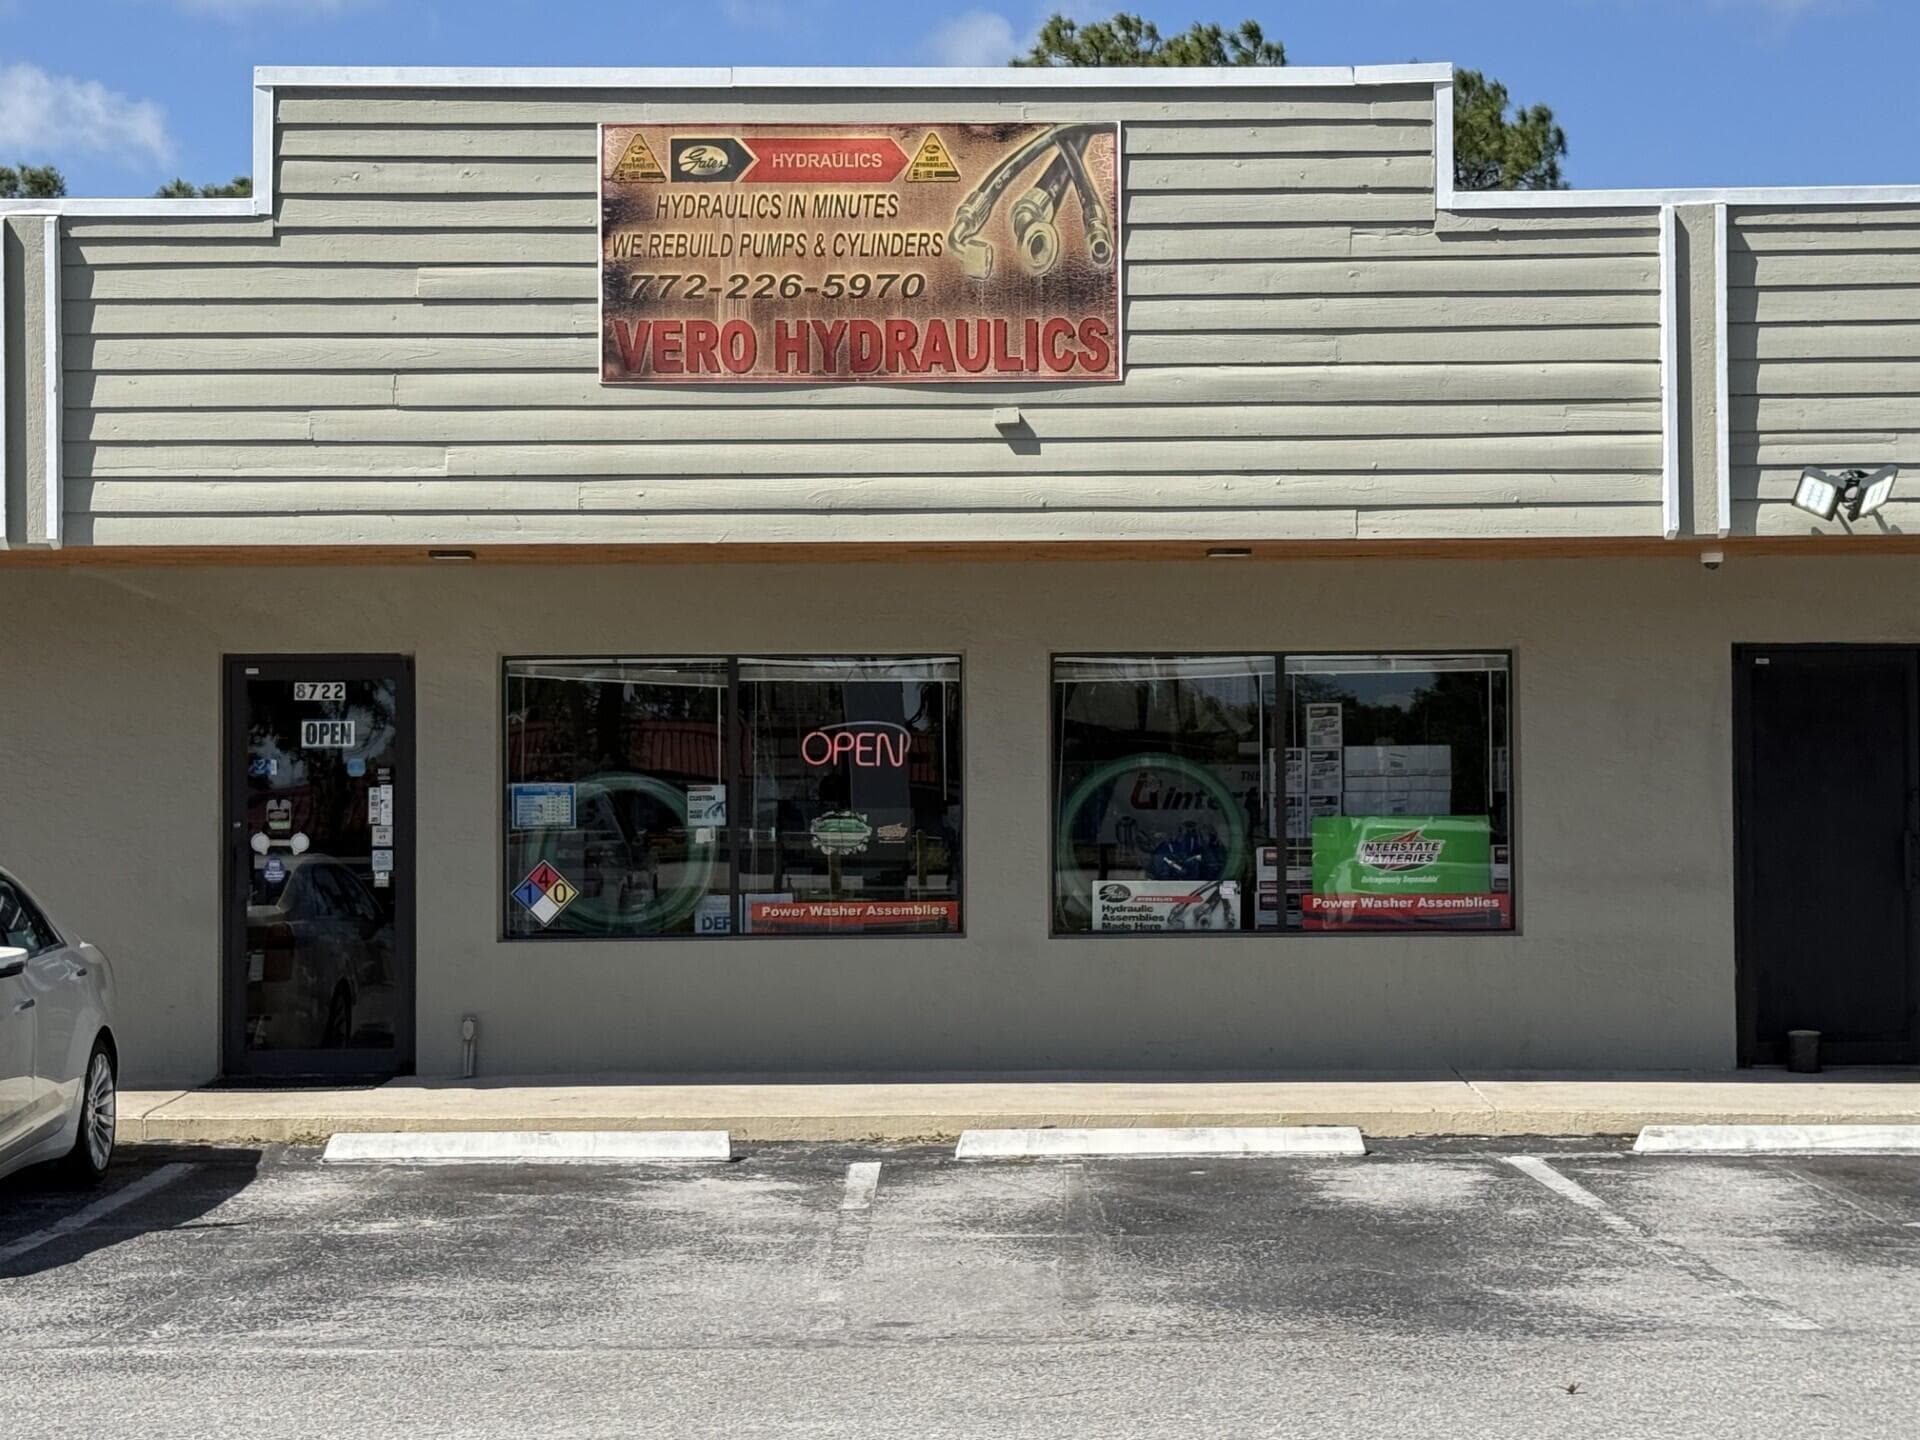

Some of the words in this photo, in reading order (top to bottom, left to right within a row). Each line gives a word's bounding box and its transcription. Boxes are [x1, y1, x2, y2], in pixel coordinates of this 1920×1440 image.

[680, 148, 728, 172] Gates
[772, 153, 883, 168] HYDRAULICS
[656, 193, 782, 220] HYDRAULICS
[787, 194, 807, 219] IN
[812, 193, 899, 219] MINUTES
[612, 233, 643, 258] WE
[649, 233, 733, 258] REBUILD
[739, 232, 807, 258] PUMPS
[813, 232, 826, 257] &
[833, 232, 943, 257] CYLINDERS
[630, 272, 926, 299] 772-226-5970
[614, 319, 757, 374] VERO
[775, 317, 1110, 374] HYDRAULICS
[296, 684, 344, 699] 8722
[305, 723, 352, 745] OPEN
[801, 731, 904, 767] OPEN
[1361, 842, 1440, 852] INTERSTATE
[538, 868, 549, 889] 4
[523, 884, 532, 904] 1
[554, 884, 567, 903] 0
[1312, 898, 1357, 909] Power
[1361, 898, 1413, 908] Washer
[1418, 897, 1500, 908] Assemblies
[762, 905, 806, 917] Power
[810, 905, 861, 917] Washer
[866, 904, 948, 916] Assemblies
[1102, 905, 1153, 914] Hydraulic
[1102, 914, 1165, 922] Assemblies
[702, 916, 731, 930] DEF
